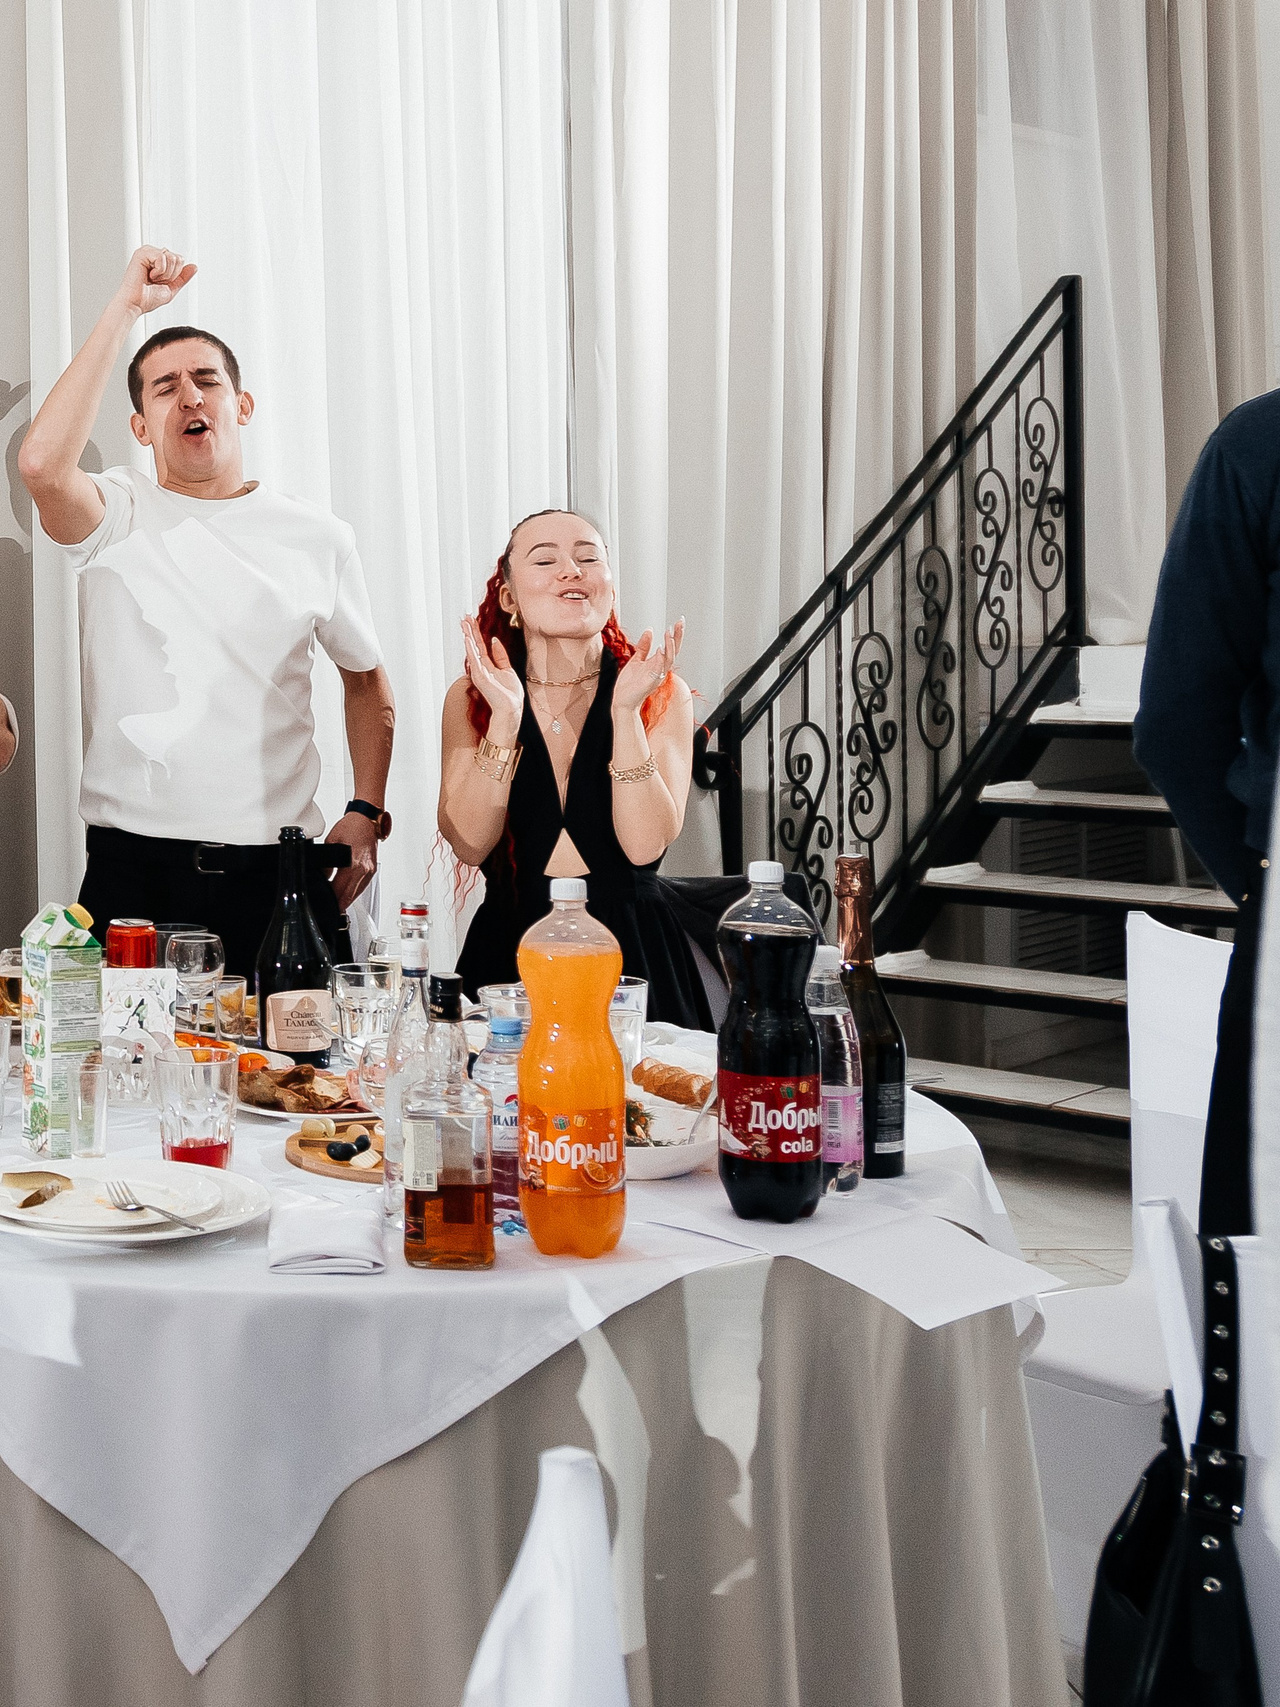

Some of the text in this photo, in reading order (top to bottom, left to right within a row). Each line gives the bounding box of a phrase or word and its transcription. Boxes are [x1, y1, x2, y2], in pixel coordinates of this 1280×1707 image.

[493, 1115, 519, 1126] ИЛИ
[747, 1101, 822, 1134] Добры
[526, 1129, 618, 1170] Добрый
[780, 1136, 814, 1154] cola
